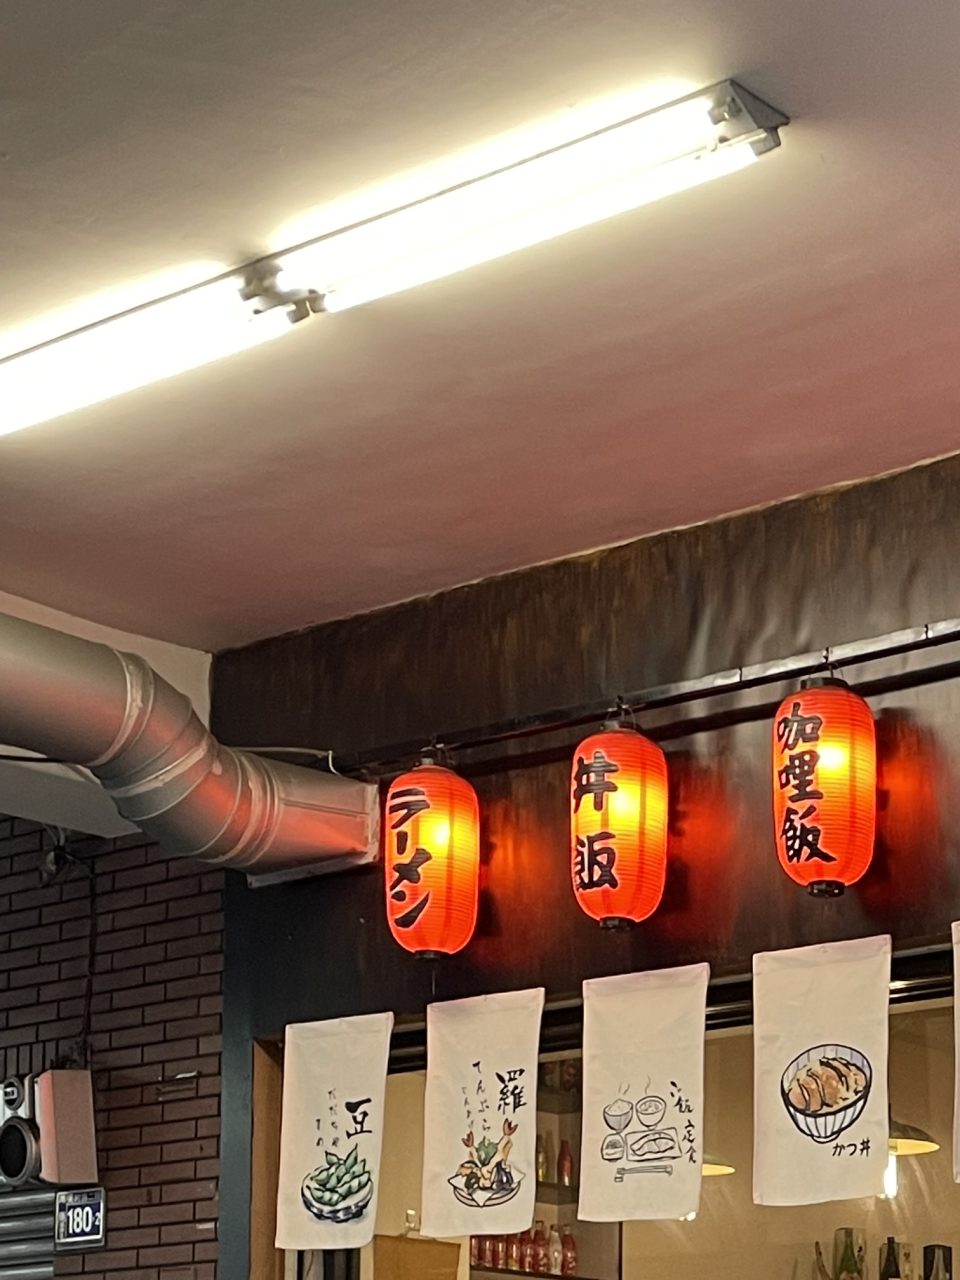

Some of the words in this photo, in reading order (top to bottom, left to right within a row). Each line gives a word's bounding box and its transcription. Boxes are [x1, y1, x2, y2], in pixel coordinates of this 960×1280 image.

[777, 702, 837, 863] 咖哩飯
[389, 788, 431, 928] ラーメン
[495, 1068, 527, 1115] 羅
[345, 1097, 372, 1139] 豆
[832, 1137, 871, 1157] かつ丼
